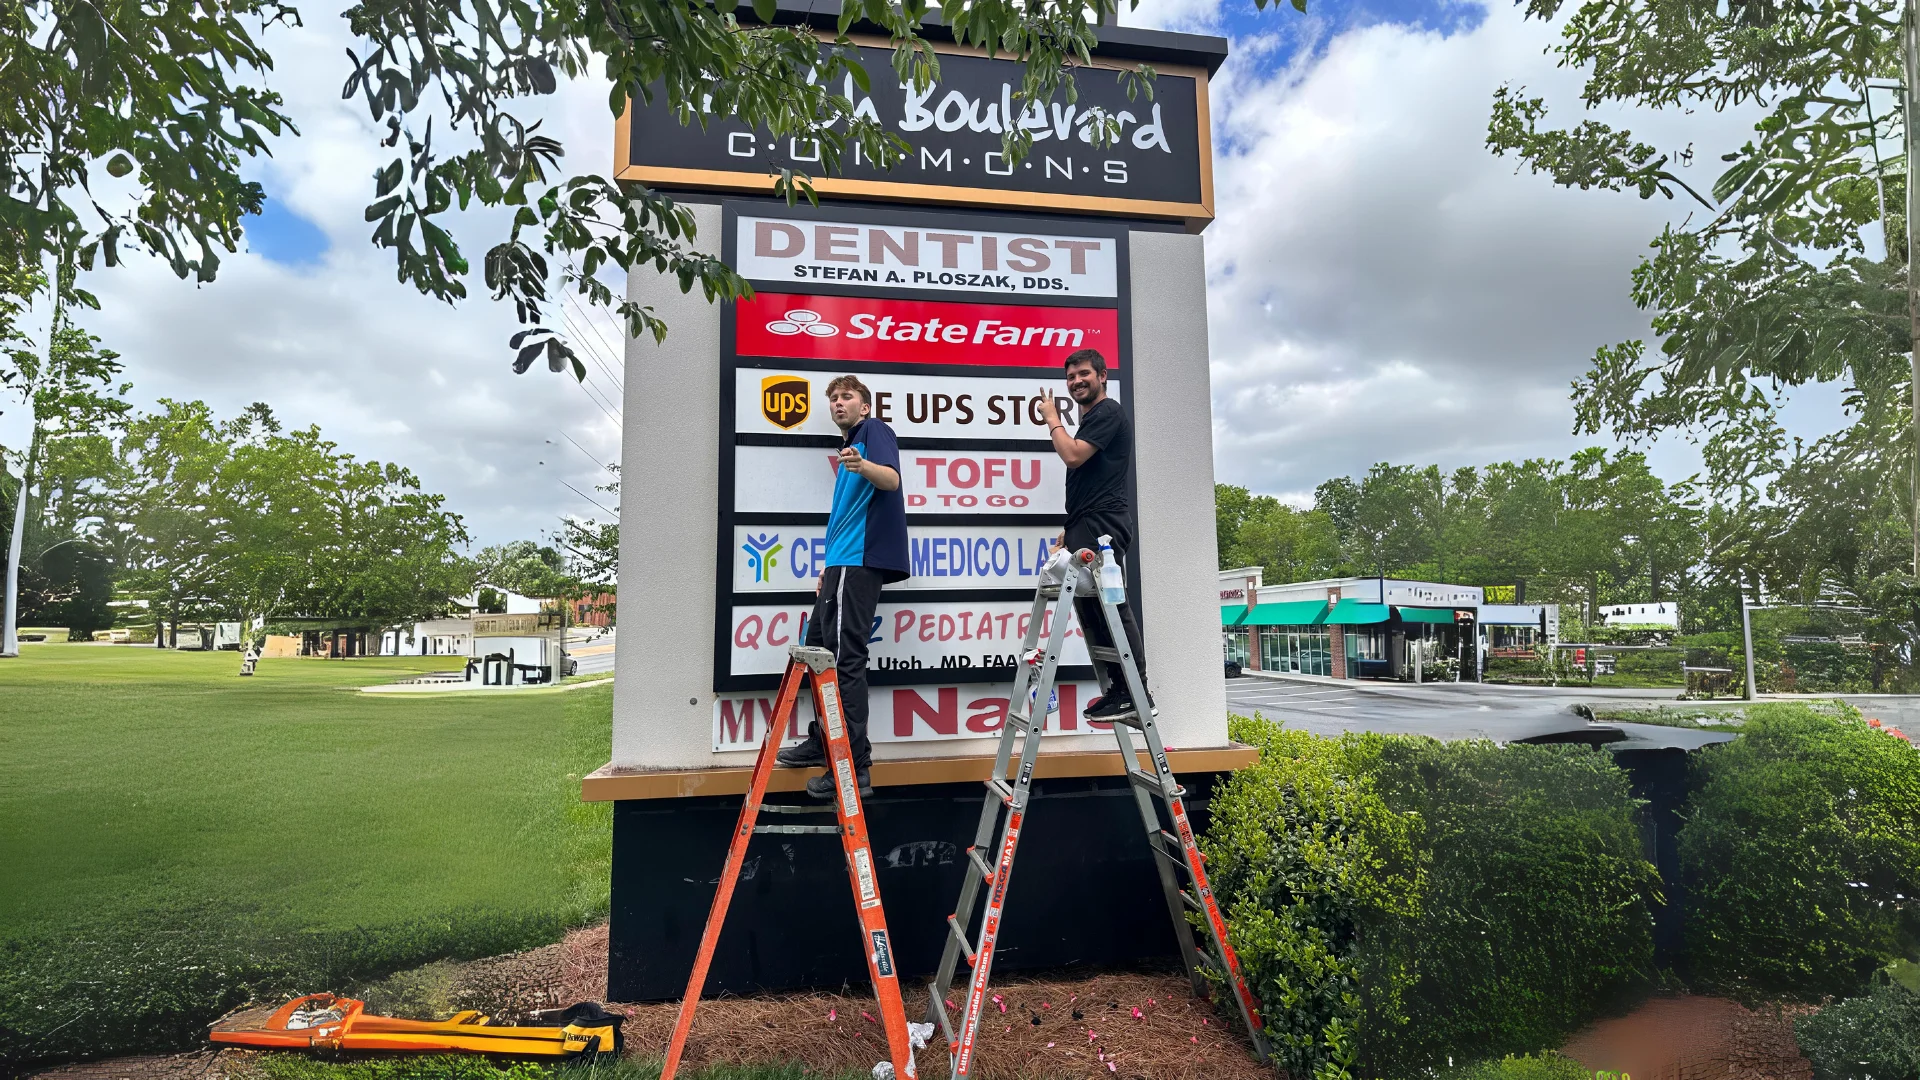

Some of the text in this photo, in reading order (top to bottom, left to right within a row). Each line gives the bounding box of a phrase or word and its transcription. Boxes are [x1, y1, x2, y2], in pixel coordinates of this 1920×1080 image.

[899, 79, 1171, 153] Boulevard
[754, 221, 1101, 275] DENTIST
[794, 265, 1069, 291] STEFAN A. PLOSZAK, DDS.
[906, 392, 974, 425] UPS
[987, 395, 1081, 426] STOR
[916, 457, 1041, 489] TOFU
[937, 494, 978, 507] TO
[986, 495, 1029, 507] GO
[911, 537, 1010, 577] MEDICO
[734, 611, 789, 650] QC
[983, 655, 1021, 668] FAA
